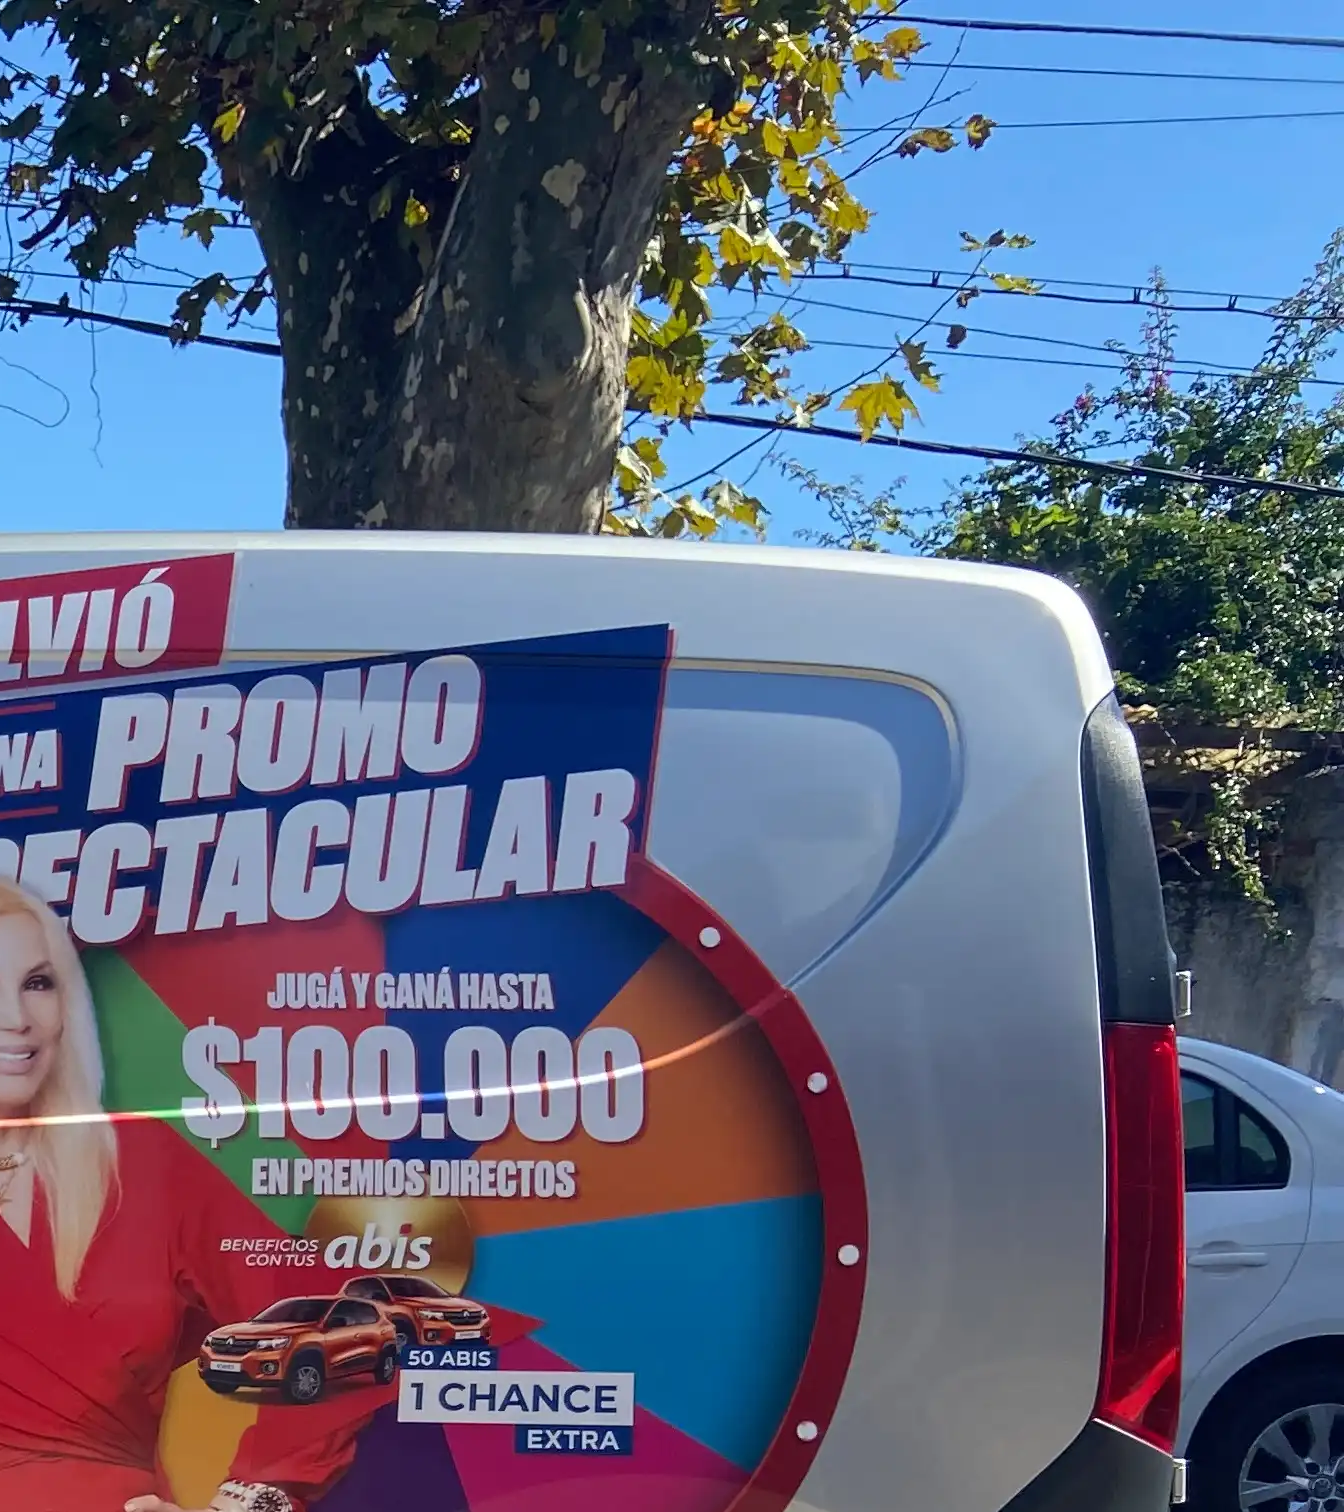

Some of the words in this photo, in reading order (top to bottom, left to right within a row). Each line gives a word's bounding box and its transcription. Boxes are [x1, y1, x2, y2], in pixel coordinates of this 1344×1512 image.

[86, 655, 484, 812] PROMO
[267, 966, 347, 1010] JUGÁ
[352, 973, 370, 1008] Y
[374, 967, 454, 1010] GANÁ
[459, 972, 555, 1011] HASTA
[181, 1016, 645, 1149] $100.000
[251, 1159, 289, 1196] EN
[294, 1158, 426, 1198] PREMIOS
[430, 1159, 576, 1198] DIRECTOS
[219, 1237, 319, 1253] BENEFICIOS
[245, 1253, 283, 1267] CON
[287, 1254, 316, 1267] TUS
[323, 1222, 433, 1270] abis
[408, 1350, 433, 1366] 50
[439, 1350, 491, 1367] ABIS
[410, 1382, 424, 1411] 1
[438, 1381, 618, 1414] CHANCE
[526, 1429, 620, 1451] EXTRA
